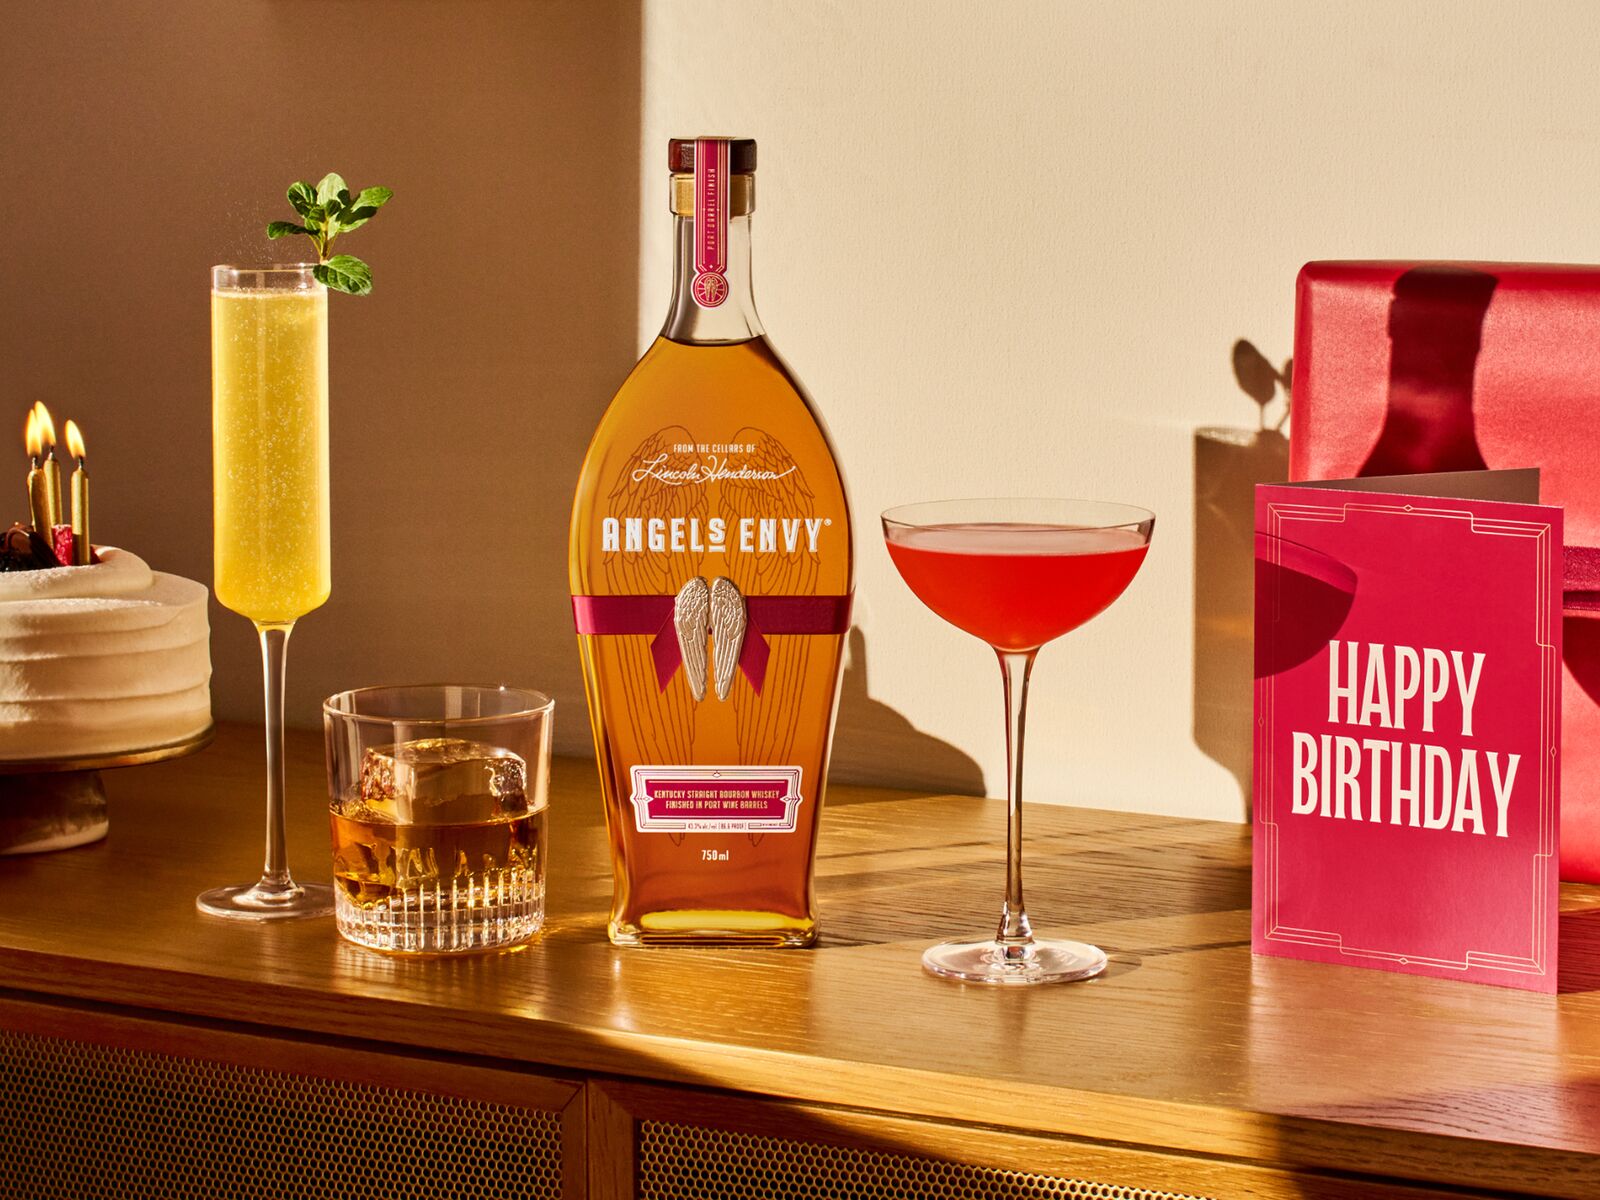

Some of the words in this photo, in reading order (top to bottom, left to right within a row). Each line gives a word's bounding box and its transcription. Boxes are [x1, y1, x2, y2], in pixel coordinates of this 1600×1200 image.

[706, 167, 716, 196] FINISH
[706, 230, 716, 251] PORT
[673, 443, 694, 453] FROM
[696, 443, 710, 453] THE
[712, 443, 744, 453] CELLARS
[746, 443, 756, 453] OF
[632, 453, 701, 486] Lincoln
[694, 455, 797, 484] Henderson
[602, 517, 726, 553] ANGELS
[1328, 639, 1487, 737] HAPPY
[654, 790, 686, 799] KENTUCKY
[687, 790, 718, 799] STRAIGHT
[719, 790, 750, 799] BOURBON
[751, 790, 780, 799] WHISKEY
[1291, 731, 1522, 838] BIRTHDAY
[665, 800, 694, 809] FINISHED
[695, 800, 703, 809] IN
[704, 800, 721, 809] PORT
[722, 800, 739, 809] WINE
[740, 800, 768, 809] BARRELS
[701, 849, 718, 861] 750
[718, 849, 729, 861] ml
